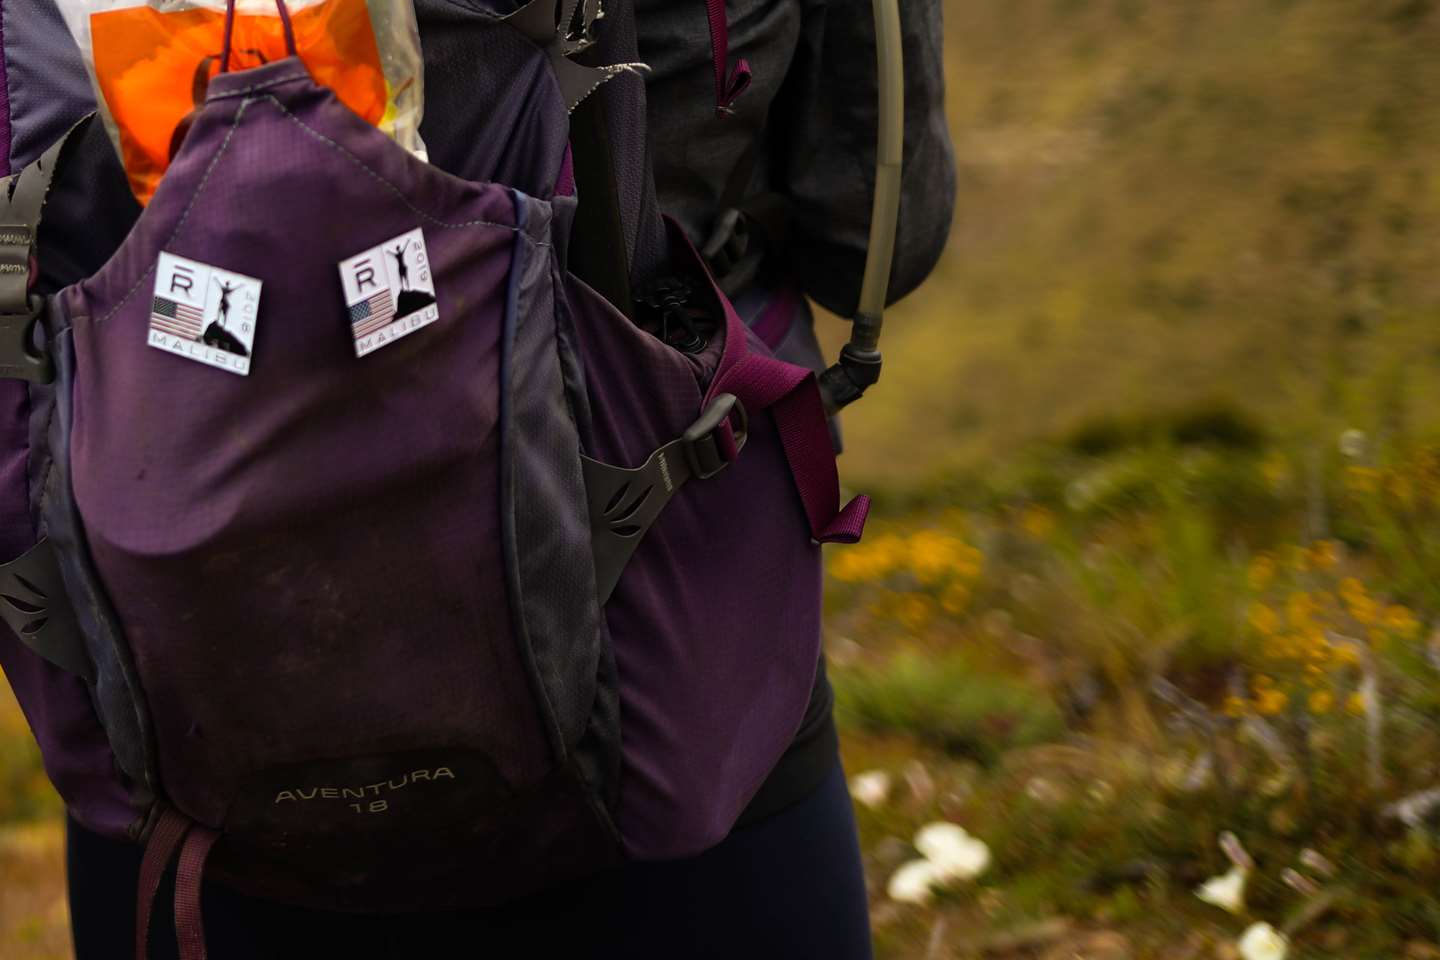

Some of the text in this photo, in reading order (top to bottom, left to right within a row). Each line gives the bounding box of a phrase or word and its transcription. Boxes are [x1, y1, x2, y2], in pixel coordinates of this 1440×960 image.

[359, 307, 436, 351] MALIBU
[152, 332, 247, 370] MALIBU
[274, 766, 456, 804] AVENTURA
[348, 799, 389, 814] 18
